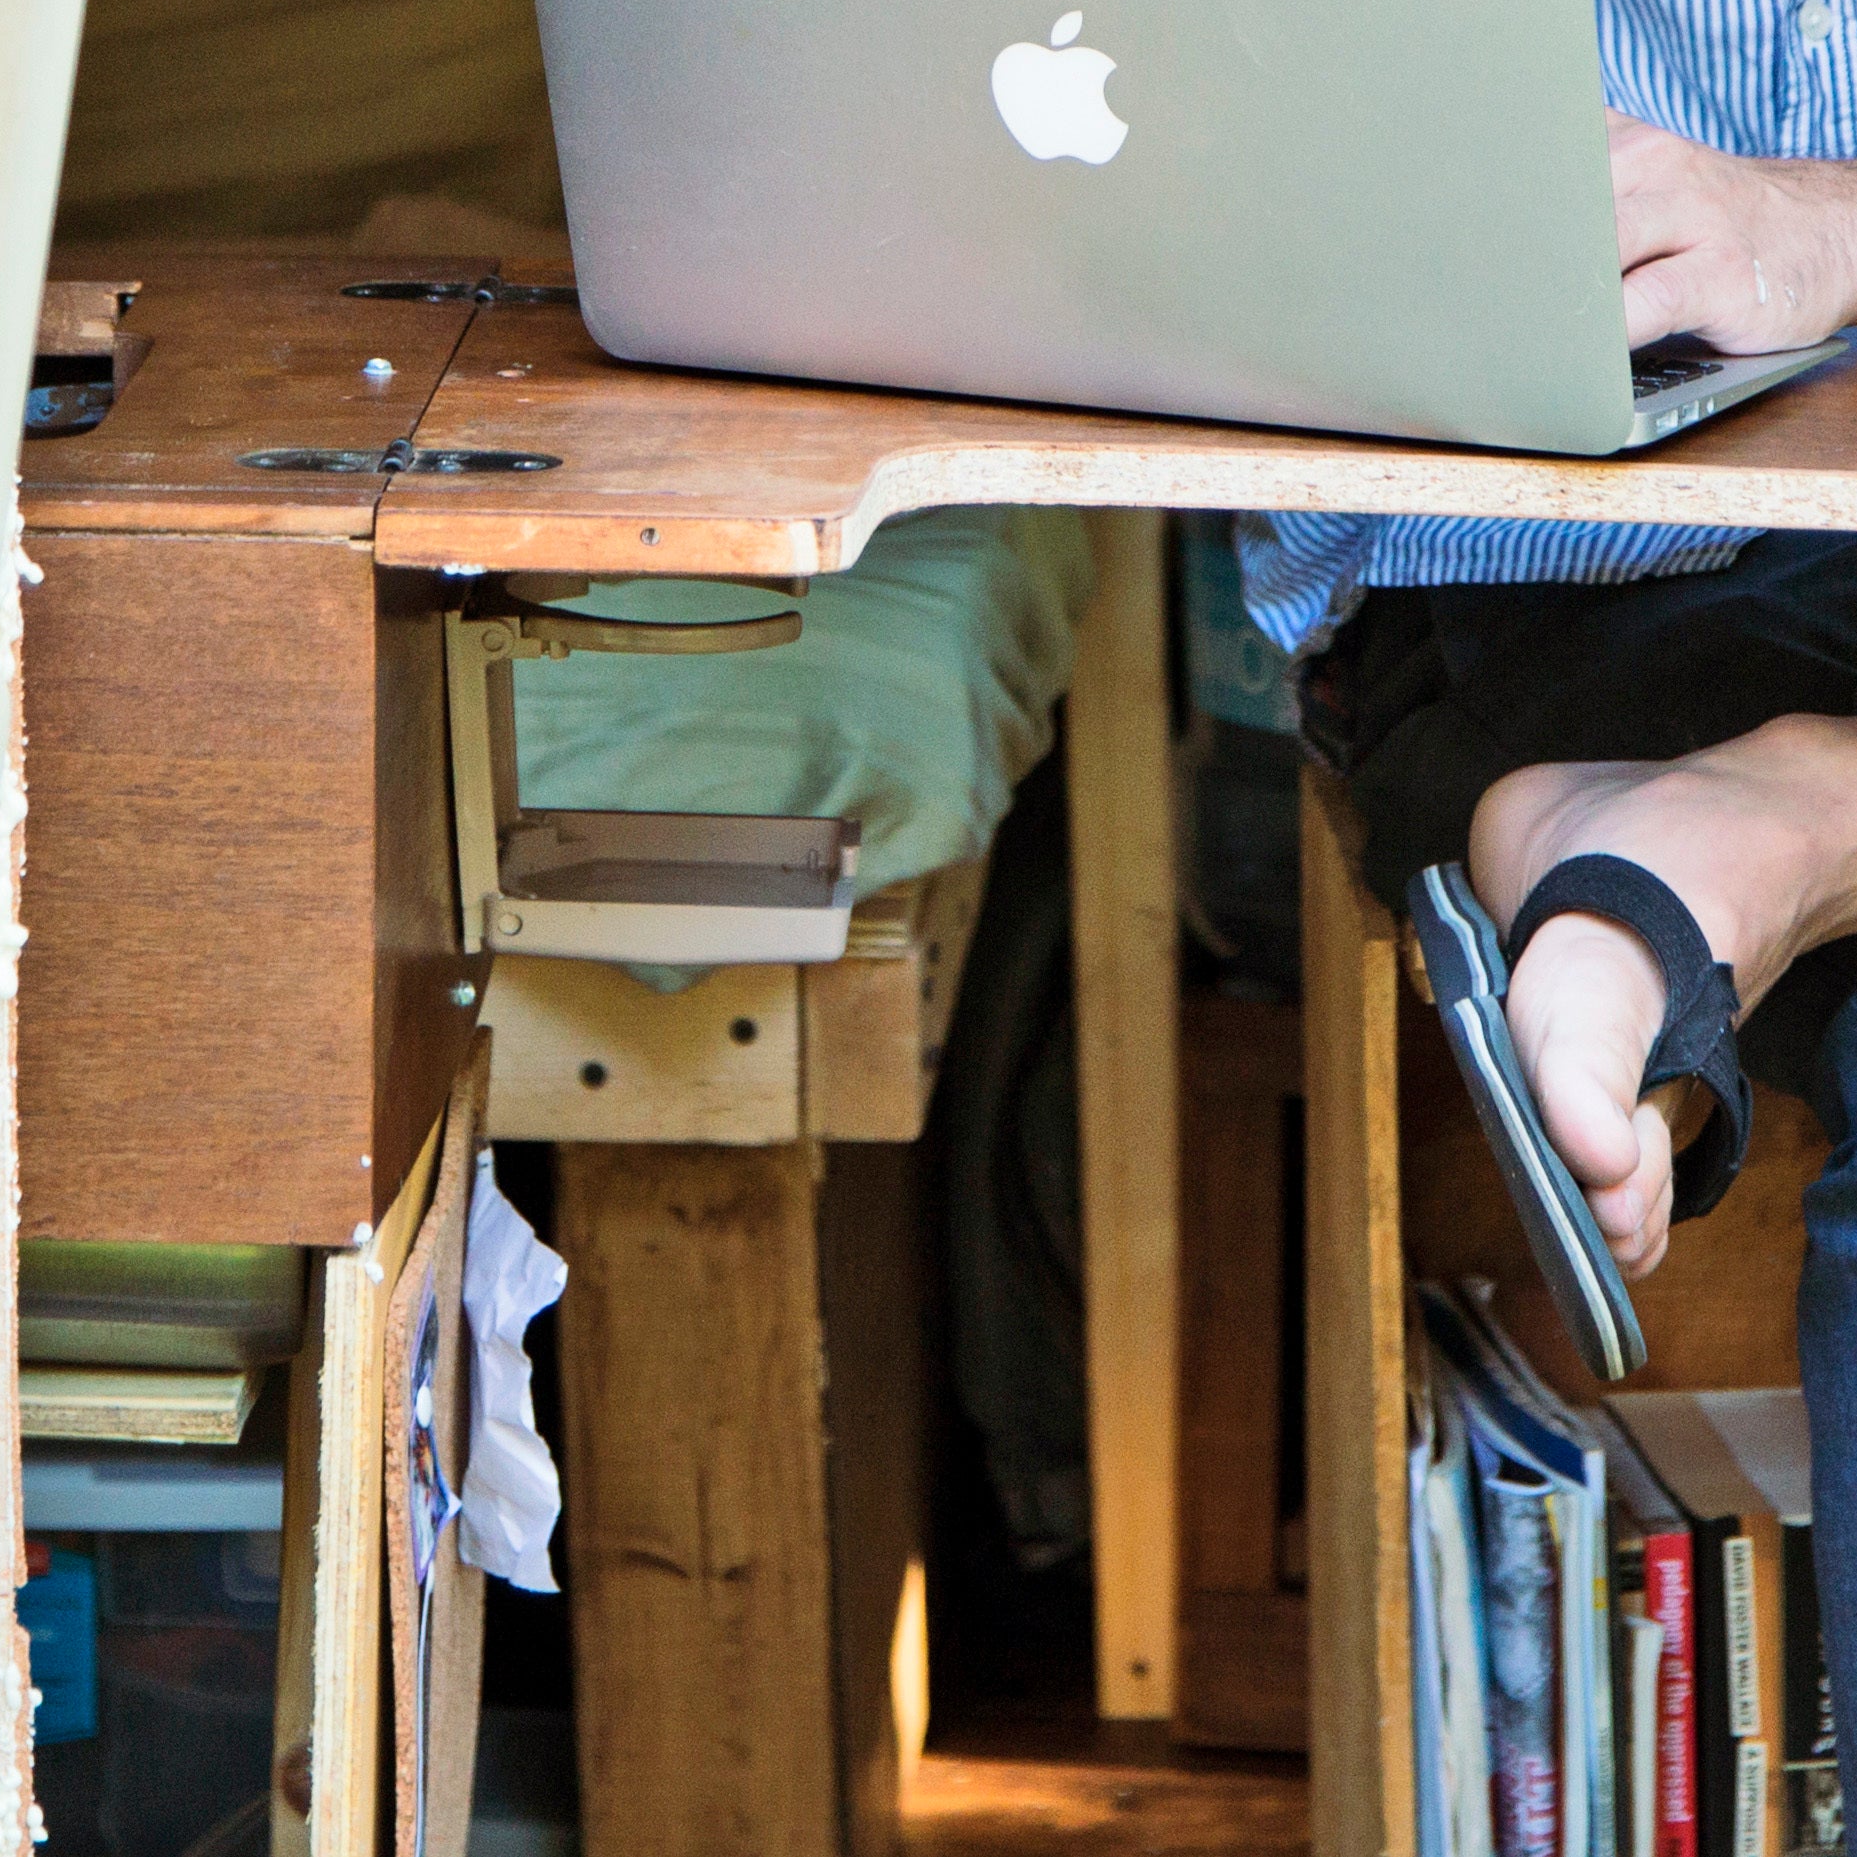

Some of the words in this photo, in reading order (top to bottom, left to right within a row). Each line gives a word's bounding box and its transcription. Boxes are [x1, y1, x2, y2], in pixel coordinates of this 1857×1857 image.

[1731, 1544, 1749, 1592] DAVID
[1653, 1559, 1691, 1656] pedagogy
[1734, 1595, 1751, 1654] FOSTER
[1664, 1659, 1694, 1680] of
[1736, 1658, 1753, 1728] WALLACE
[1662, 1682, 1693, 1718] the
[1658, 1719, 1696, 1824] oppressed
